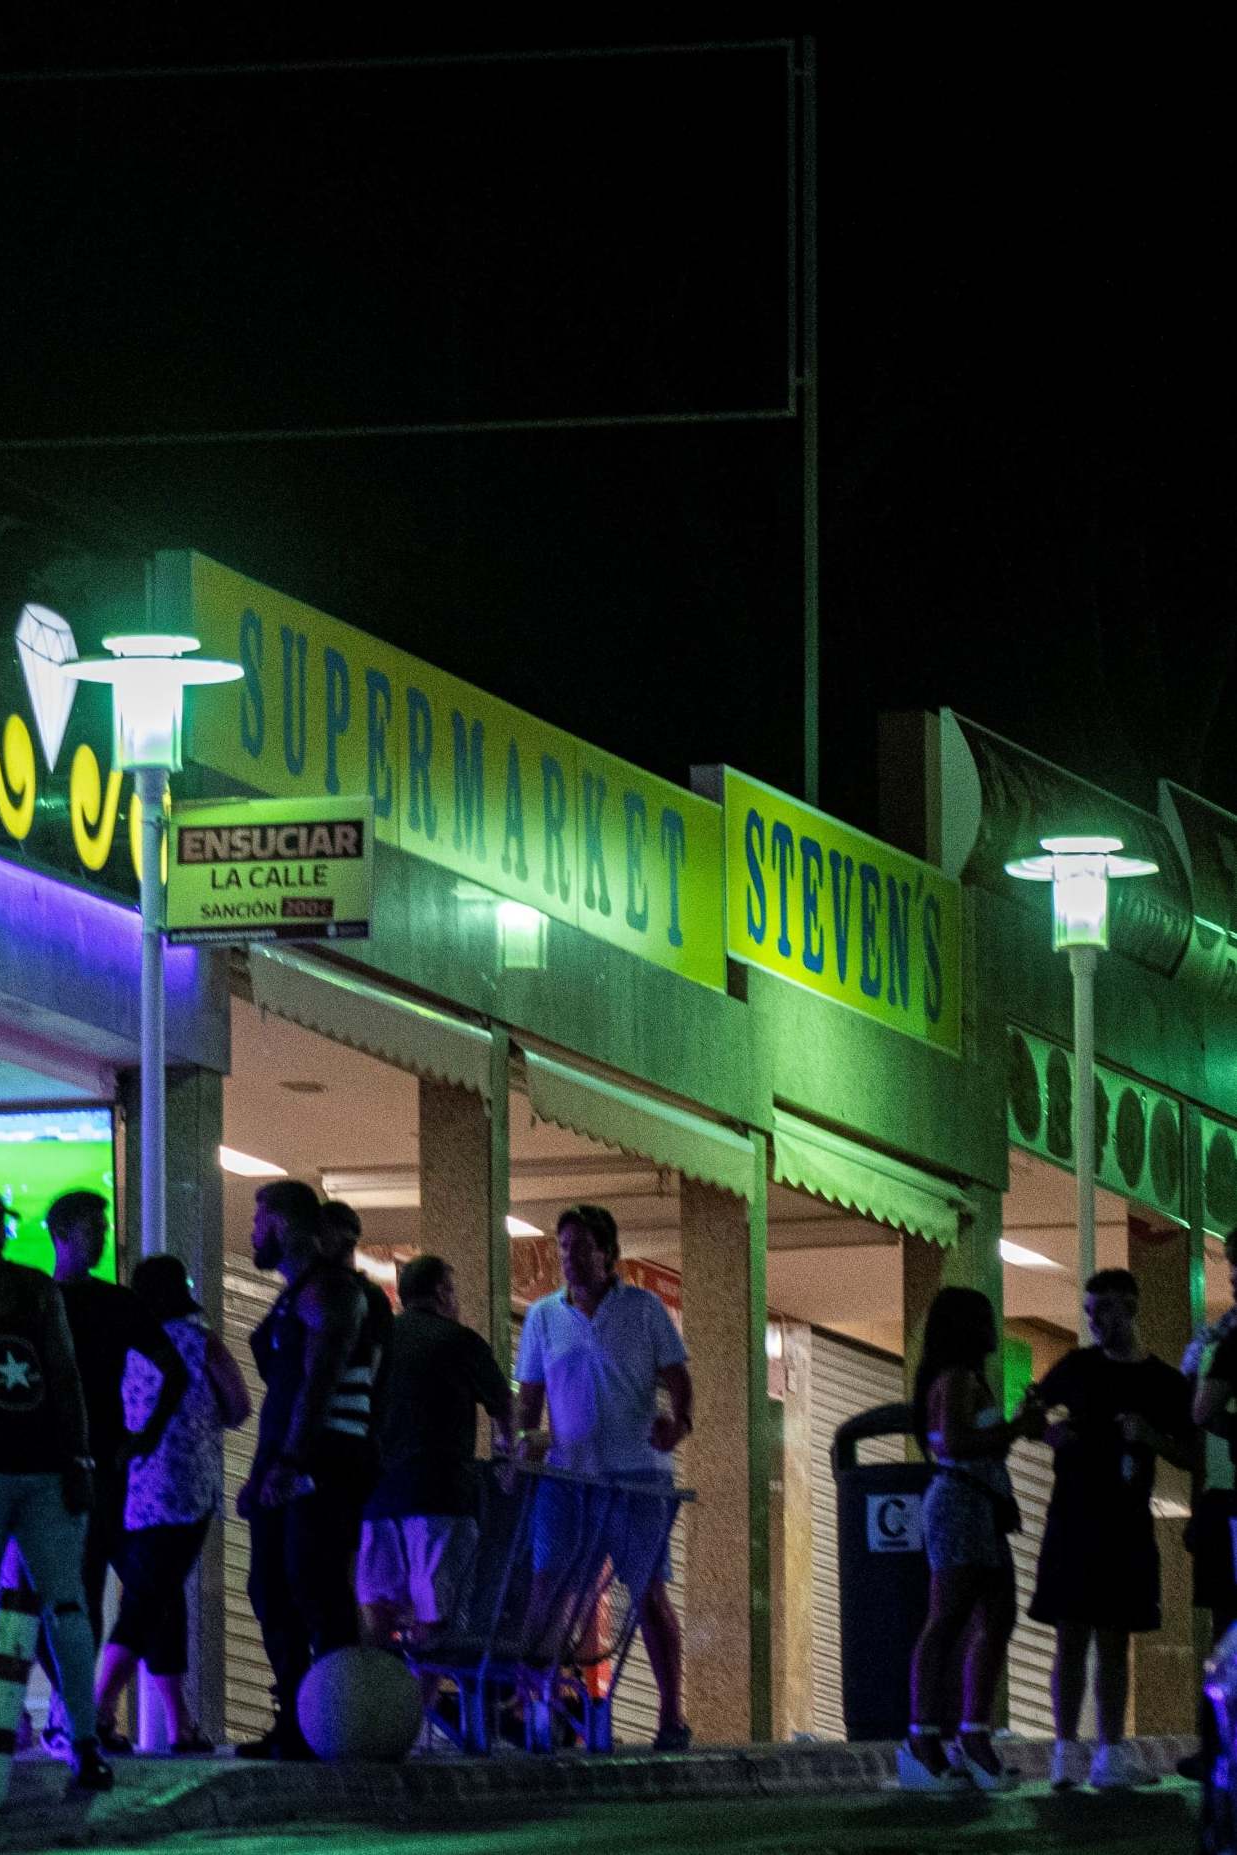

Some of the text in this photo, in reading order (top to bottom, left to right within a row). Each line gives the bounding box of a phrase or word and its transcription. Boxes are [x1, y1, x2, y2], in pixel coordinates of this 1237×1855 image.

[238, 606, 686, 949] SUPERMARKET
[180, 824, 359, 862] ENSUCIAR
[211, 863, 329, 890] LA CALLE
[200, 898, 277, 919] SANCIÓN
[744, 807, 943, 1024] STEVEN'S
